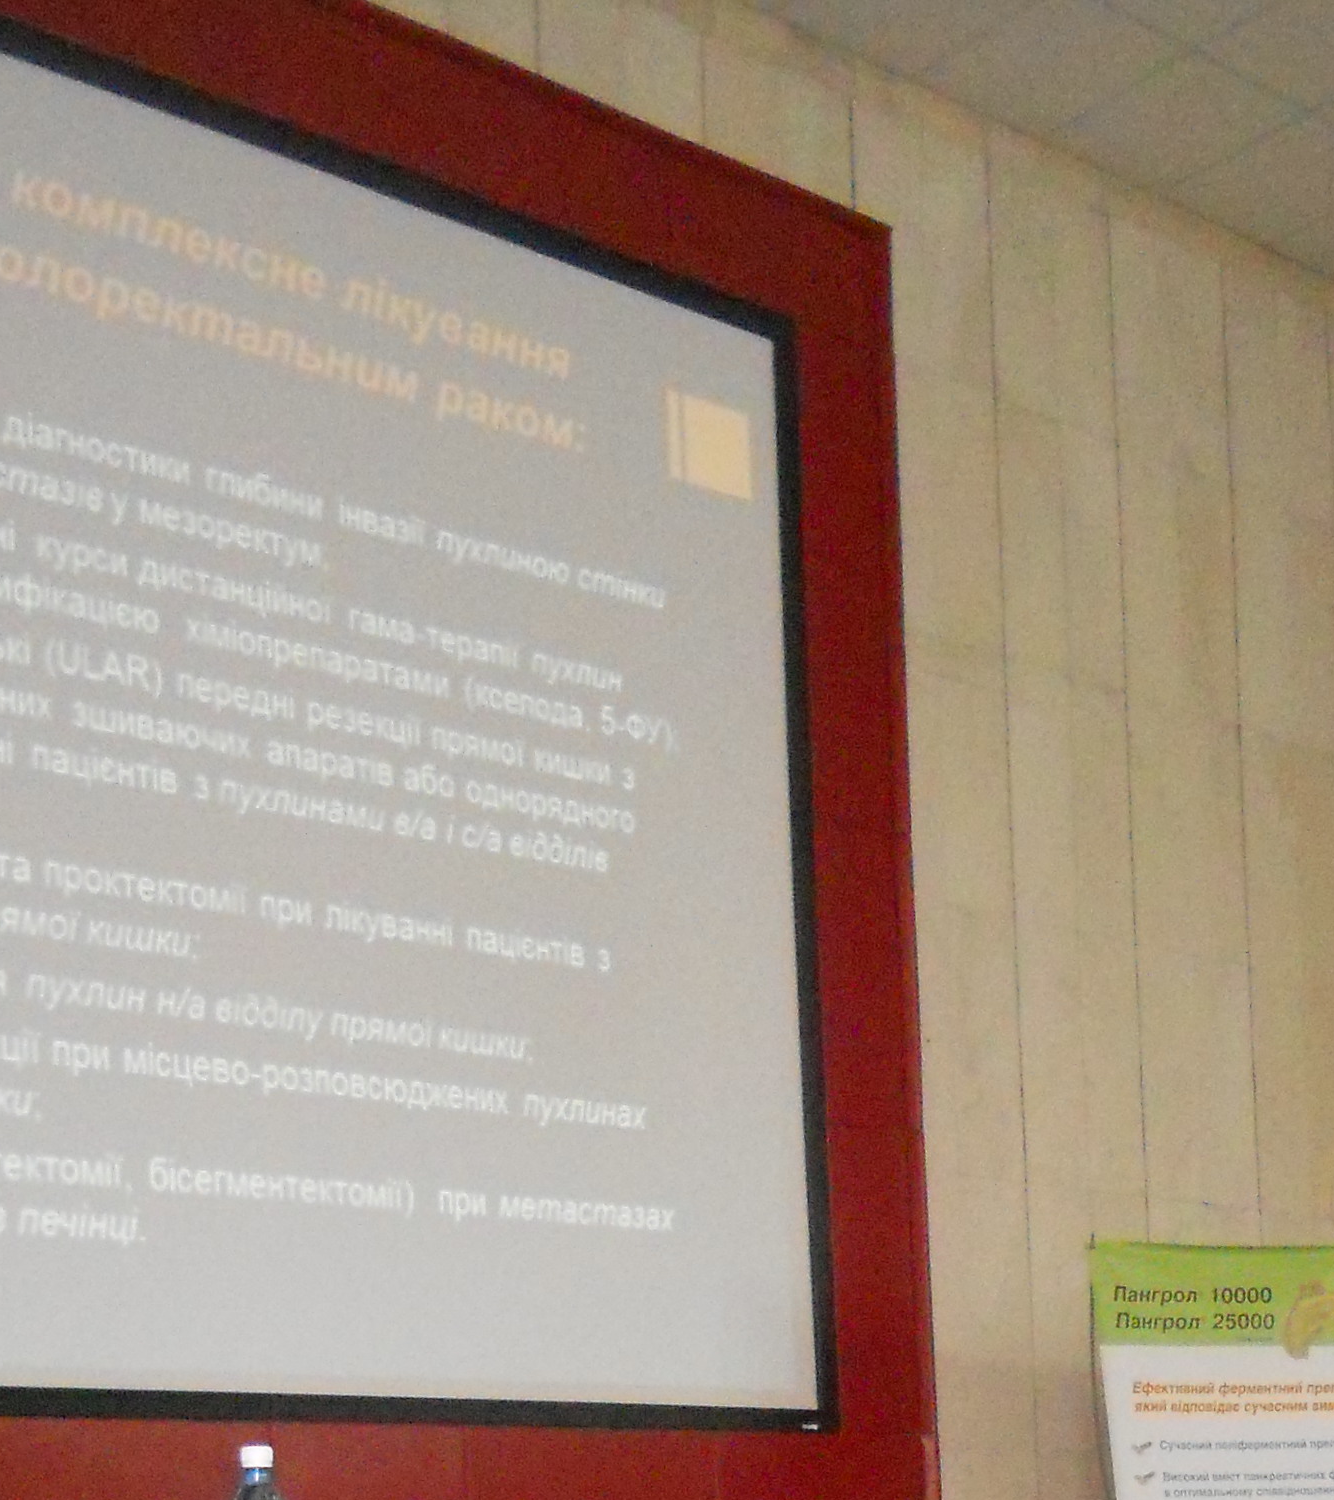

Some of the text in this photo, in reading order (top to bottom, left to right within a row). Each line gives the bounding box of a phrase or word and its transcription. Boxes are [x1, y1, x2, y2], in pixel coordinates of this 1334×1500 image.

[12, 170, 328, 297] комплексне
[342, 273, 570, 380] лікування
[1, 411, 190, 485] діагностики
[205, 466, 324, 521] глибини
[338, 496, 425, 546] інвазії
[436, 530, 570, 585] пухлиною
[577, 567, 666, 610] стінки
[110, 491, 130, 527] у
[34, 534, 128, 577] курси
[137, 559, 331, 624] дистанційної
[348, 607, 519, 669] гама-терапії
[531, 650, 623, 693] пухлин
[187, 613, 450, 698] хіміопрепаратами
[44, 636, 163, 700] (ULAR)
[176, 670, 296, 721] передні
[307, 700, 422, 749] резекції
[431, 725, 524, 768] прямої
[533, 747, 613, 786] кишки
[621, 767, 636, 792] з
[30, 743, 179, 795] пацієнтів
[193, 774, 211, 801] з
[217, 778, 386, 832] пухлинами
[393, 808, 438, 841] в/а
[446, 814, 456, 844] і
[461, 820, 503, 854] с/а
[509, 831, 611, 874] відділів
[72, 700, 252, 759] зшиваючих
[267, 740, 394, 787] апаратів
[403, 763, 456, 799] або
[465, 779, 636, 834] однорядного
[43, 859, 247, 915] проктектомії
[259, 893, 313, 930] при
[324, 900, 454, 948] лікуванні
[466, 925, 585, 970] пацієнтів
[597, 947, 612, 973] з
[25, 972, 146, 1012] пухлин
[157, 986, 206, 1021] н/а
[215, 992, 323, 1043] відділу
[330, 1010, 433, 1045] прямої
[52, 1038, 110, 1077] при
[123, 1041, 509, 1116] місцево-розповсюджених
[523, 1092, 648, 1131] пухлинах
[18, 1203, 147, 1247] печінці.
[148, 1155, 415, 1219] бісегментектомії)
[437, 1187, 487, 1222] при
[497, 1193, 675, 1232] метастазах
[1113, 1285, 1273, 1306] Пангрол 10000
[1116, 1311, 1275, 1333] Пангрол 25000
[1132, 1381, 1215, 1397] Ефективний
[1218, 1380, 1303, 1399] ферментний
[1134, 1399, 1167, 1412] який
[1171, 1400, 1240, 1415] відповідає
[1243, 1402, 1308, 1416] сучасним
